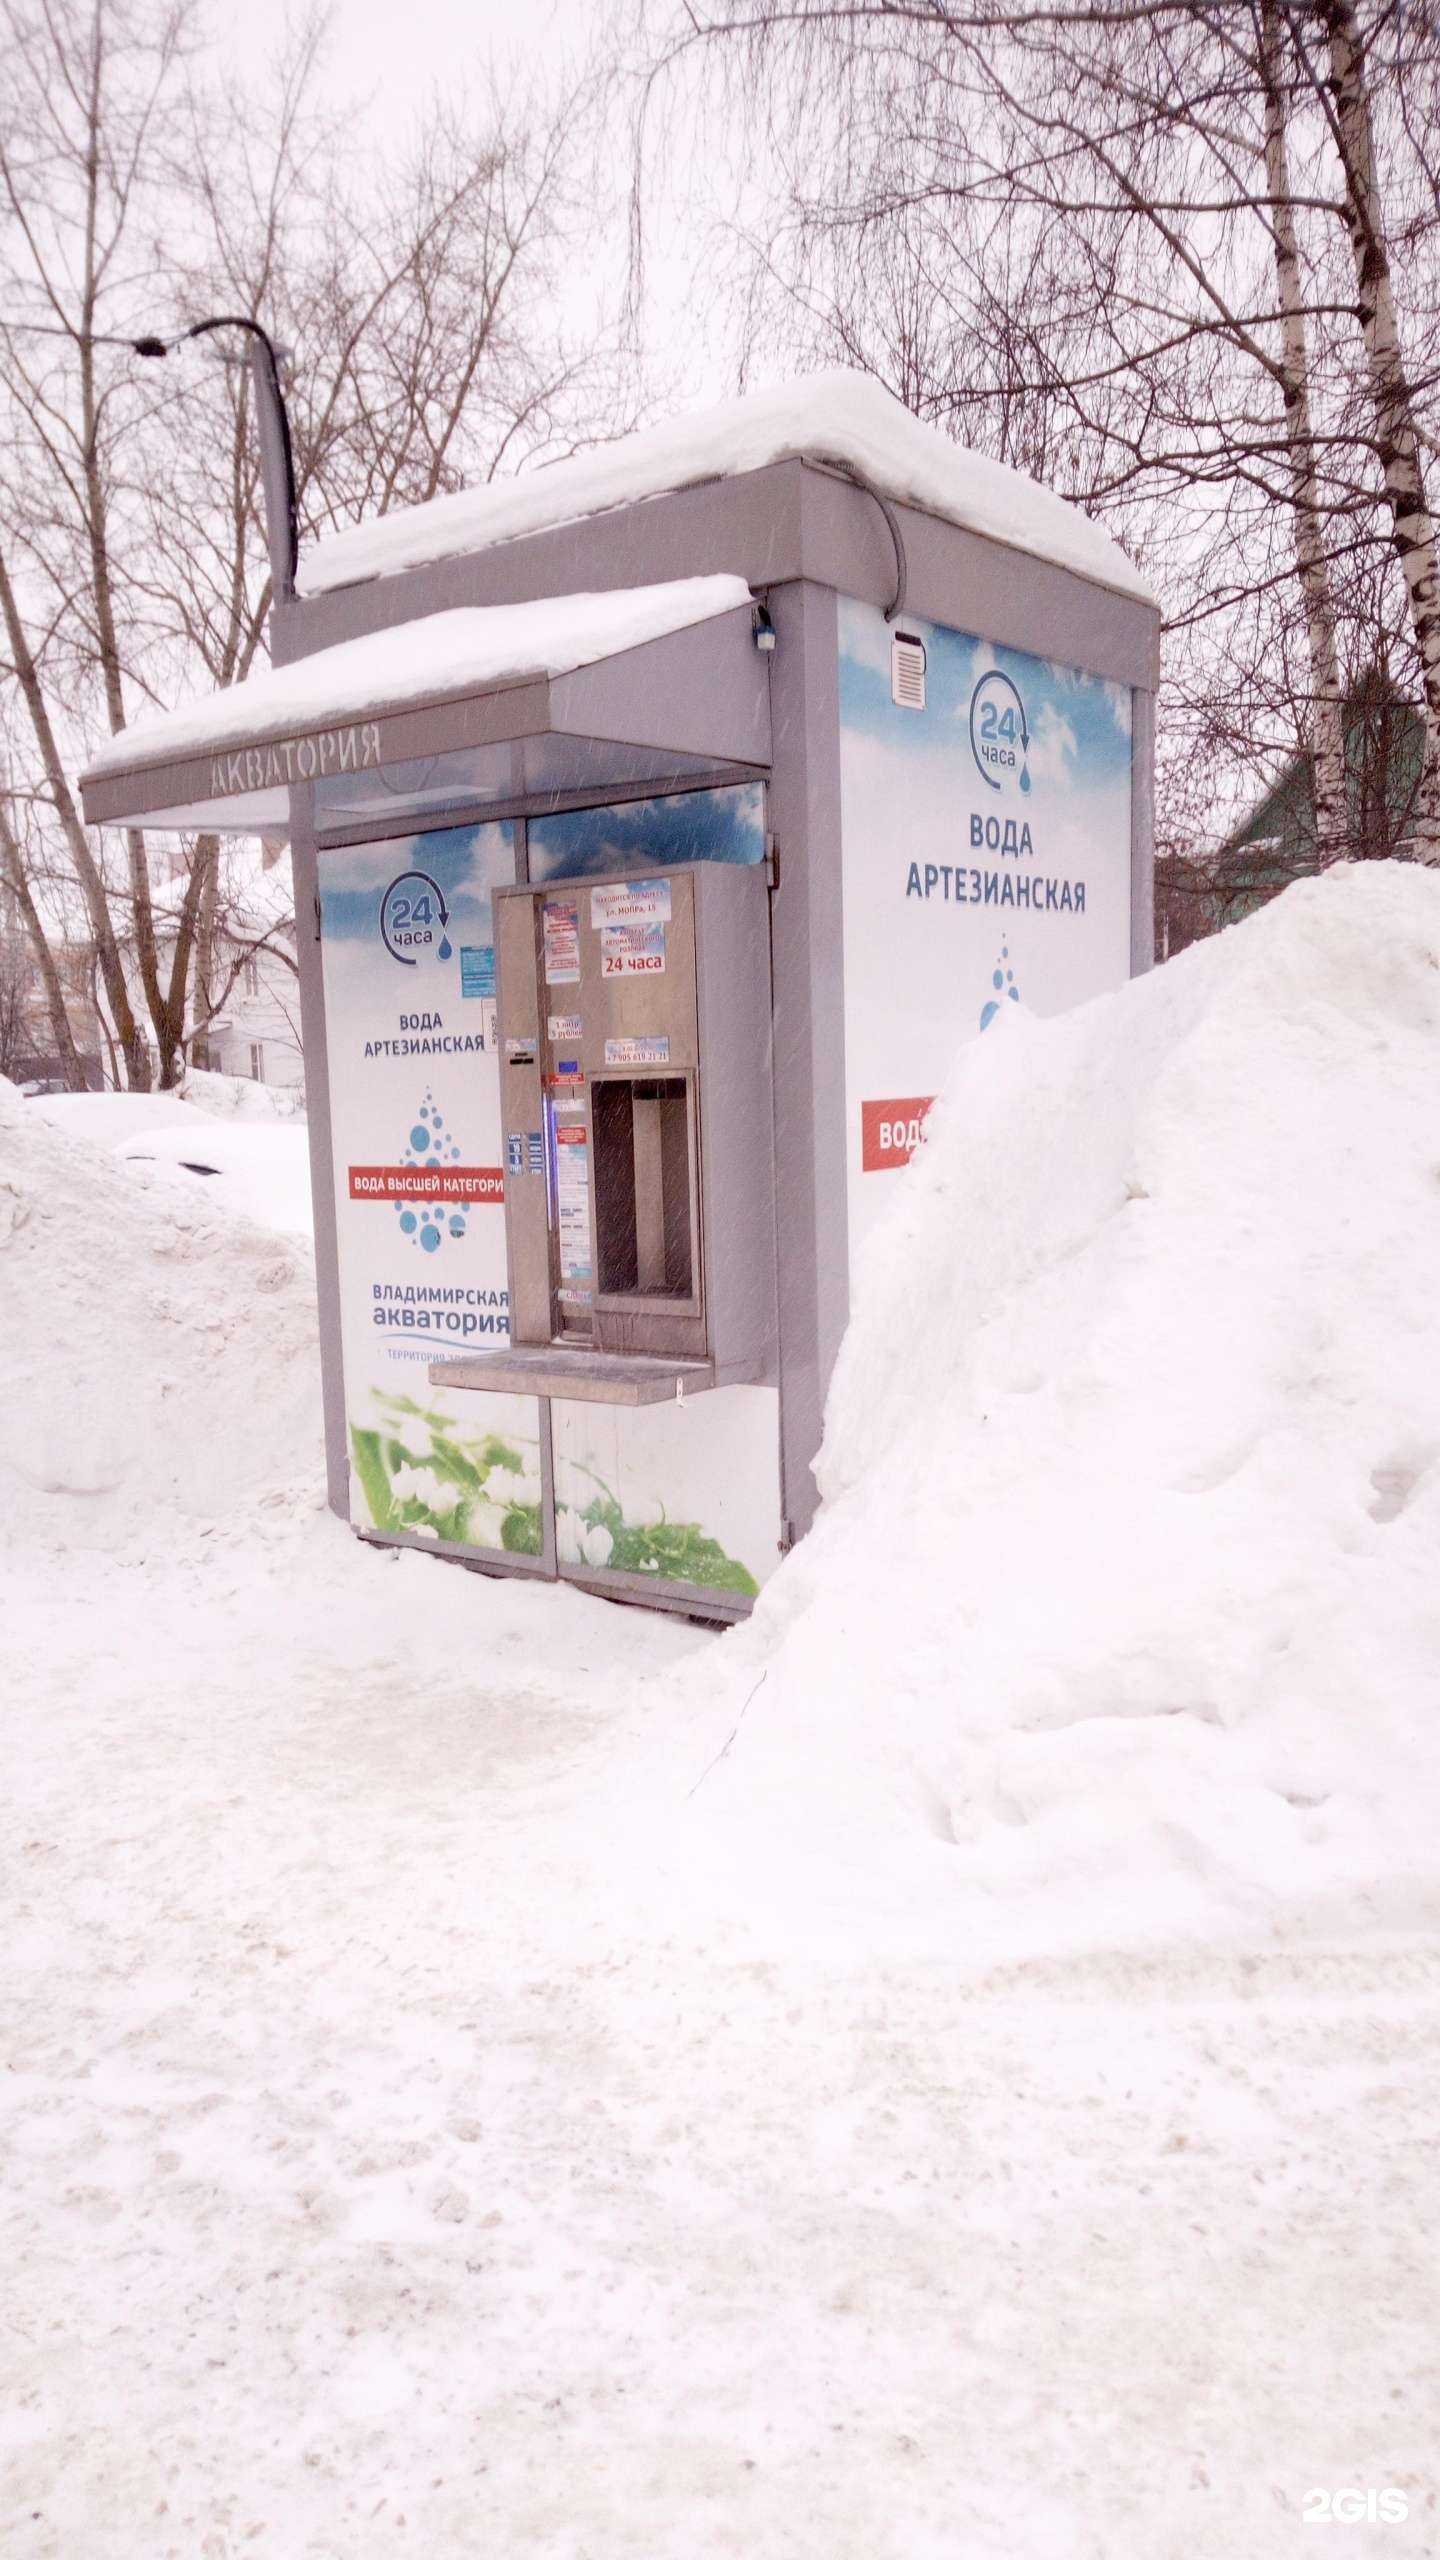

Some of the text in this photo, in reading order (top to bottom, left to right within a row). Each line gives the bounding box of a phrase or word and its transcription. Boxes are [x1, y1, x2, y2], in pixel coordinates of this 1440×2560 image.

[981, 701, 1016, 744] 24
[211, 723, 381, 796] АКВАТОРИЯ
[981, 745, 1016, 766] часа
[970, 813, 1033, 857] ВОДА
[906, 862, 1086, 912] АРТЕЗИАНСКАЯ
[391, 896, 433, 929] 24
[394, 930, 432, 946] часа
[606, 956, 662, 972] 24 часа
[400, 1013, 442, 1031] ВОДА
[364, 1035, 485, 1057] АРТЕЗИАНСКАЯ
[880, 1119, 921, 1152] ВОД
[354, 1175, 504, 1193] ВОДА ВЫСШЕЙ КАТЕГОРИ
[373, 1284, 509, 1307] ВЛАДИМИРСКАЯ
[373, 1307, 510, 1336] акватория
